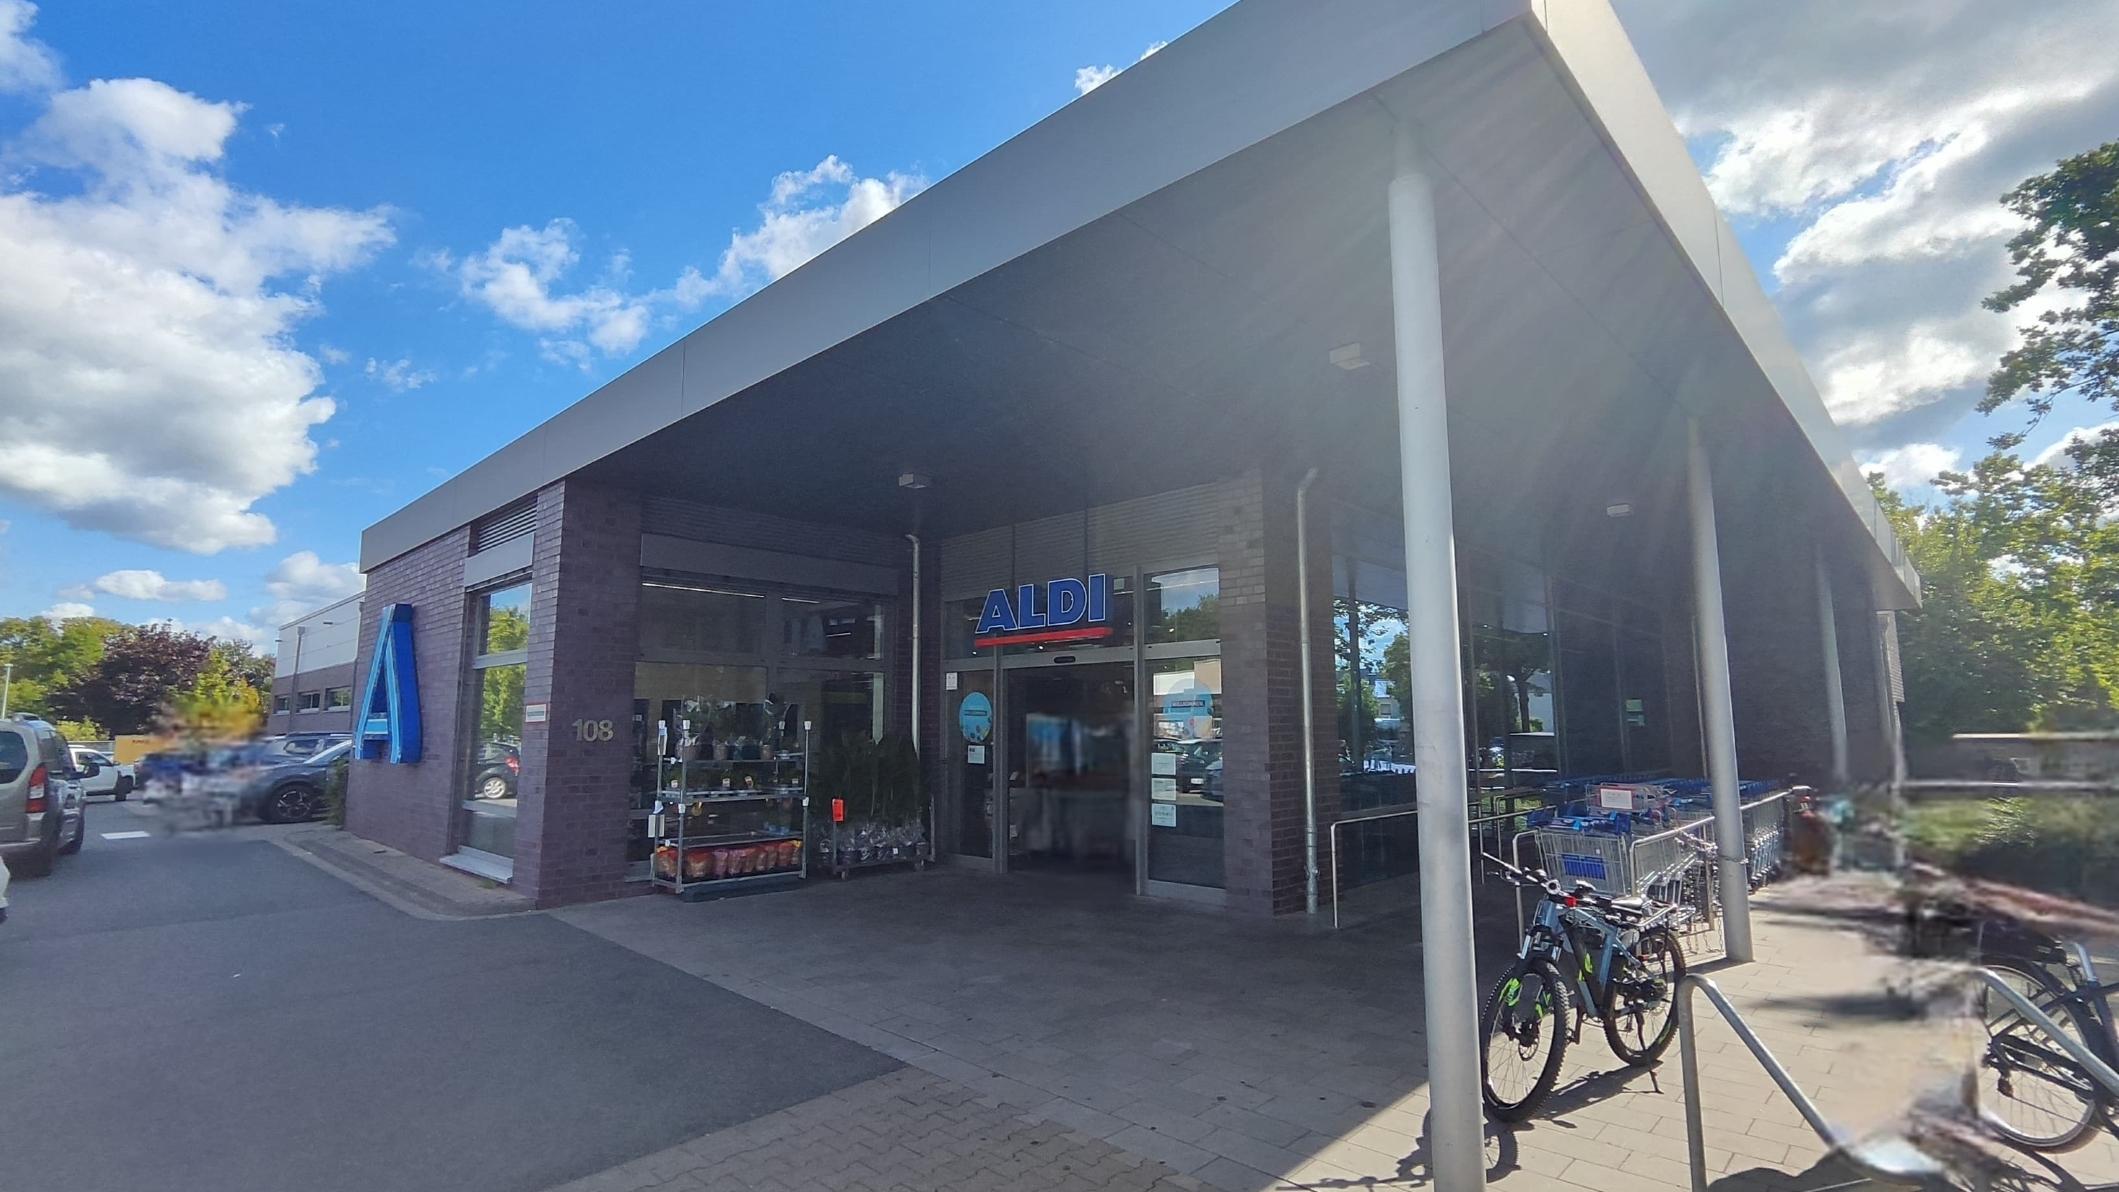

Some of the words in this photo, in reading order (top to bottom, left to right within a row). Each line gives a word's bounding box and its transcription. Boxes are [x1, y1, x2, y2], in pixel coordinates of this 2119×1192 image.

[975, 573, 1106, 634] ALDI
[354, 603, 422, 764] A
[572, 718, 614, 742] 108
